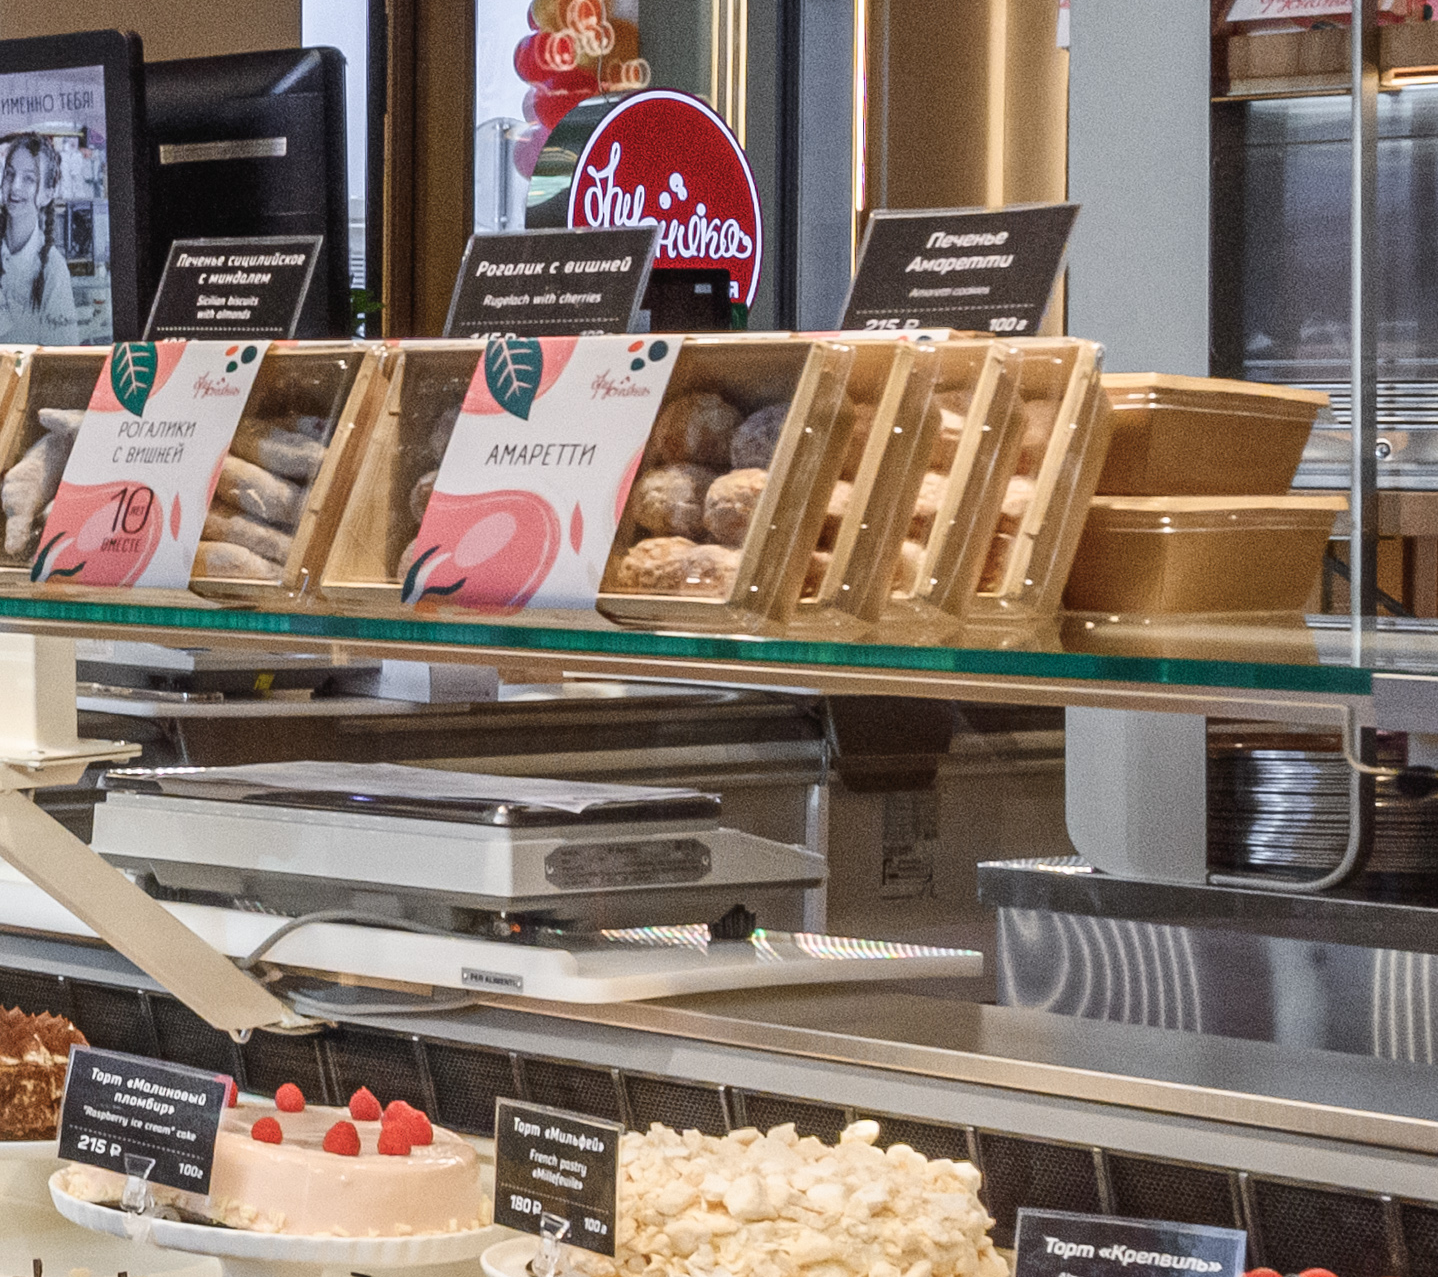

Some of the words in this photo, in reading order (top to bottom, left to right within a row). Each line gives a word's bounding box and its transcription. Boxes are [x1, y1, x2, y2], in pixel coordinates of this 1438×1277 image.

[2, 94, 54, 116] ИМЕННО
[60, 90, 94, 111] ТЕБЯ!
[584, 142, 752, 259] Бруника
[926, 231, 1009, 249] Печенье
[176, 253, 225, 267] Печенье
[228, 252, 306, 268] сицилийское
[475, 261, 545, 277] Рогалик
[549, 261, 560, 274] с
[564, 256, 632, 274] вишней
[905, 254, 1014, 275] Амаретти
[198, 273, 207, 284] с
[208, 270, 271, 284] миндалем
[483, 294, 529, 308] Rugelach
[533, 293, 556, 305] with
[559, 292, 602, 304] cherries
[989, 317, 1017, 332] 100
[118, 421, 197, 438] РОГАЛИКИ
[112, 447, 122, 463] С
[125, 443, 185, 464] ВИШНЕЙ
[485, 444, 598, 466] АМАРЕТТИ
[111, 486, 154, 534] 10
[100, 537, 141, 552] ВМЕСТЕ
[91, 1067, 123, 1086] Торт
[126, 1078, 207, 1106] «Малиновый
[114, 1092, 175, 1115] пломбир»
[131, 1117, 143, 1129] ice
[176, 1129, 197, 1142] cake
[514, 1117, 540, 1137] Торт
[545, 1126, 604, 1153] «Мильфей»
[77, 1134, 107, 1154] 215
[529, 1148, 558, 1166] French
[560, 1158, 587, 1178] pastry
[510, 1194, 531, 1213] 180
[584, 1217, 600, 1232] 100
[1043, 1235, 1094, 1260] Торт
[1098, 1245, 1223, 1273] «Крепвиль»
